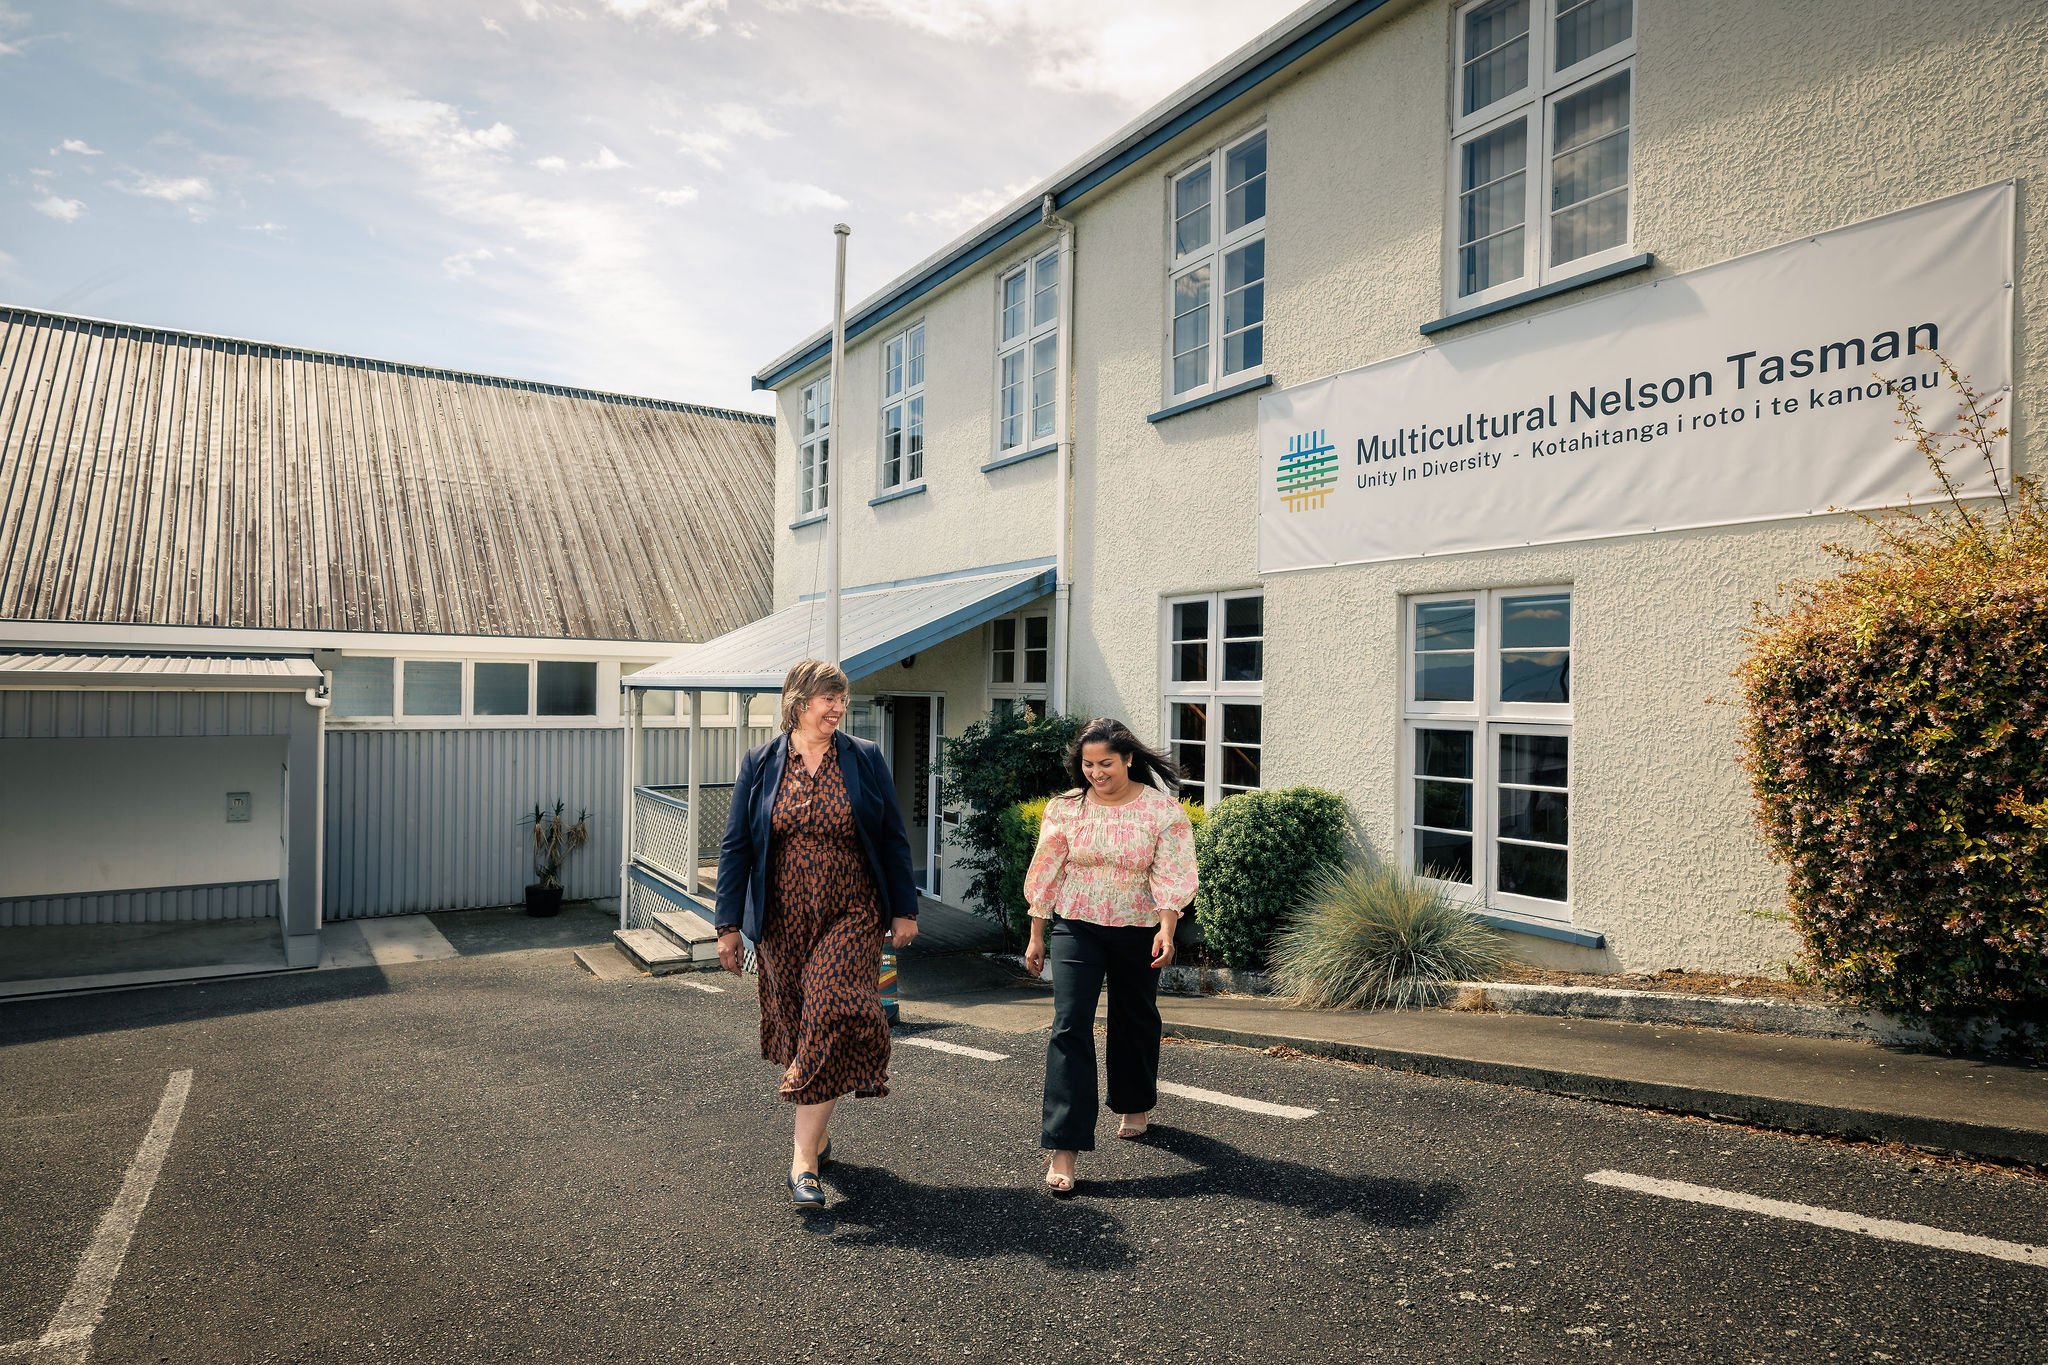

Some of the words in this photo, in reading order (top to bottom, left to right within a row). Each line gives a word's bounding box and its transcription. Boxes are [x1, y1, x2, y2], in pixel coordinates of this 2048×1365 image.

[1357, 395, 1558, 466] Multicultural
[1569, 370, 1713, 424] Nelson
[1726, 322, 1940, 391] Tasman
[1357, 471, 1398, 489] Unity
[1402, 467, 1417, 481] In
[1422, 452, 1502, 478] Diversity
[1532, 421, 1668, 459] Kotahitanga
[1678, 414, 1683, 433] i
[1692, 405, 1745, 430] roto
[1755, 399, 1761, 420] i
[1770, 396, 1799, 417] te
[1809, 371, 1939, 409] kanorau
